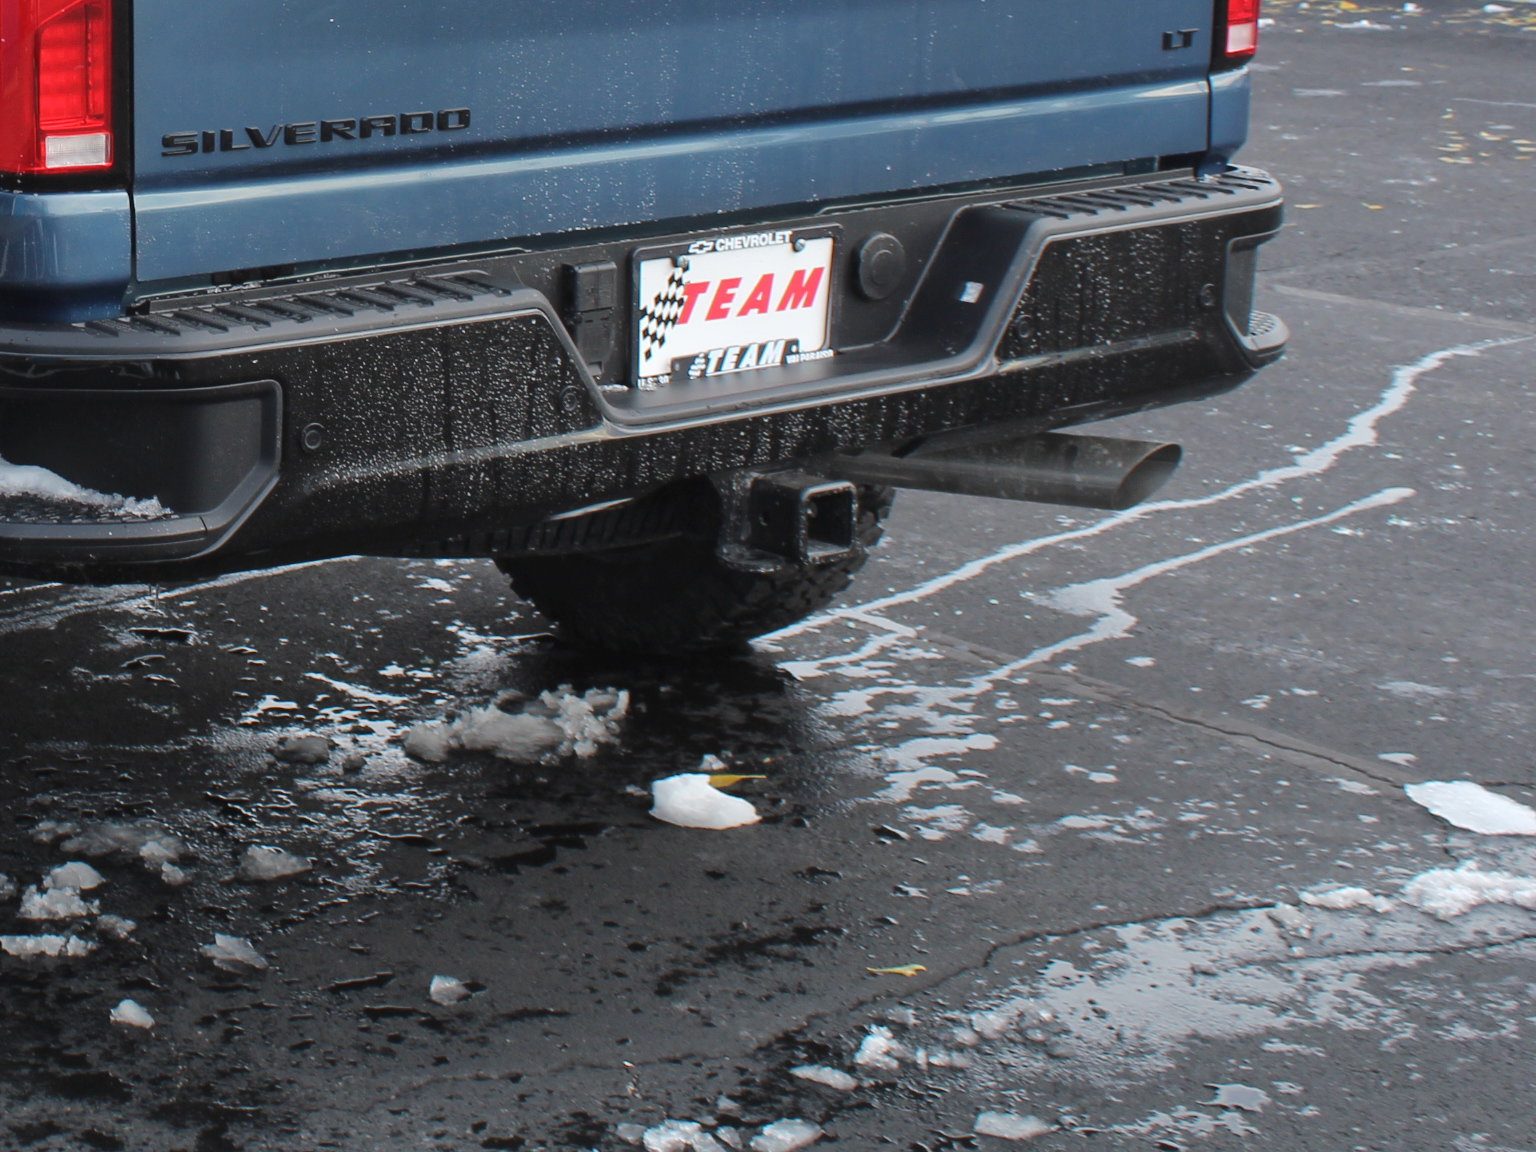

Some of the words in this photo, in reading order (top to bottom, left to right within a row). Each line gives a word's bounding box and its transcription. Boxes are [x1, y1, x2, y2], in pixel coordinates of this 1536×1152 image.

[1162, 27, 1200, 51] LT
[161, 107, 471, 157] SILVERADO
[715, 231, 793, 252] CHEVROLET
[677, 266, 825, 325] TEAM
[705, 338, 786, 376] TEAM
